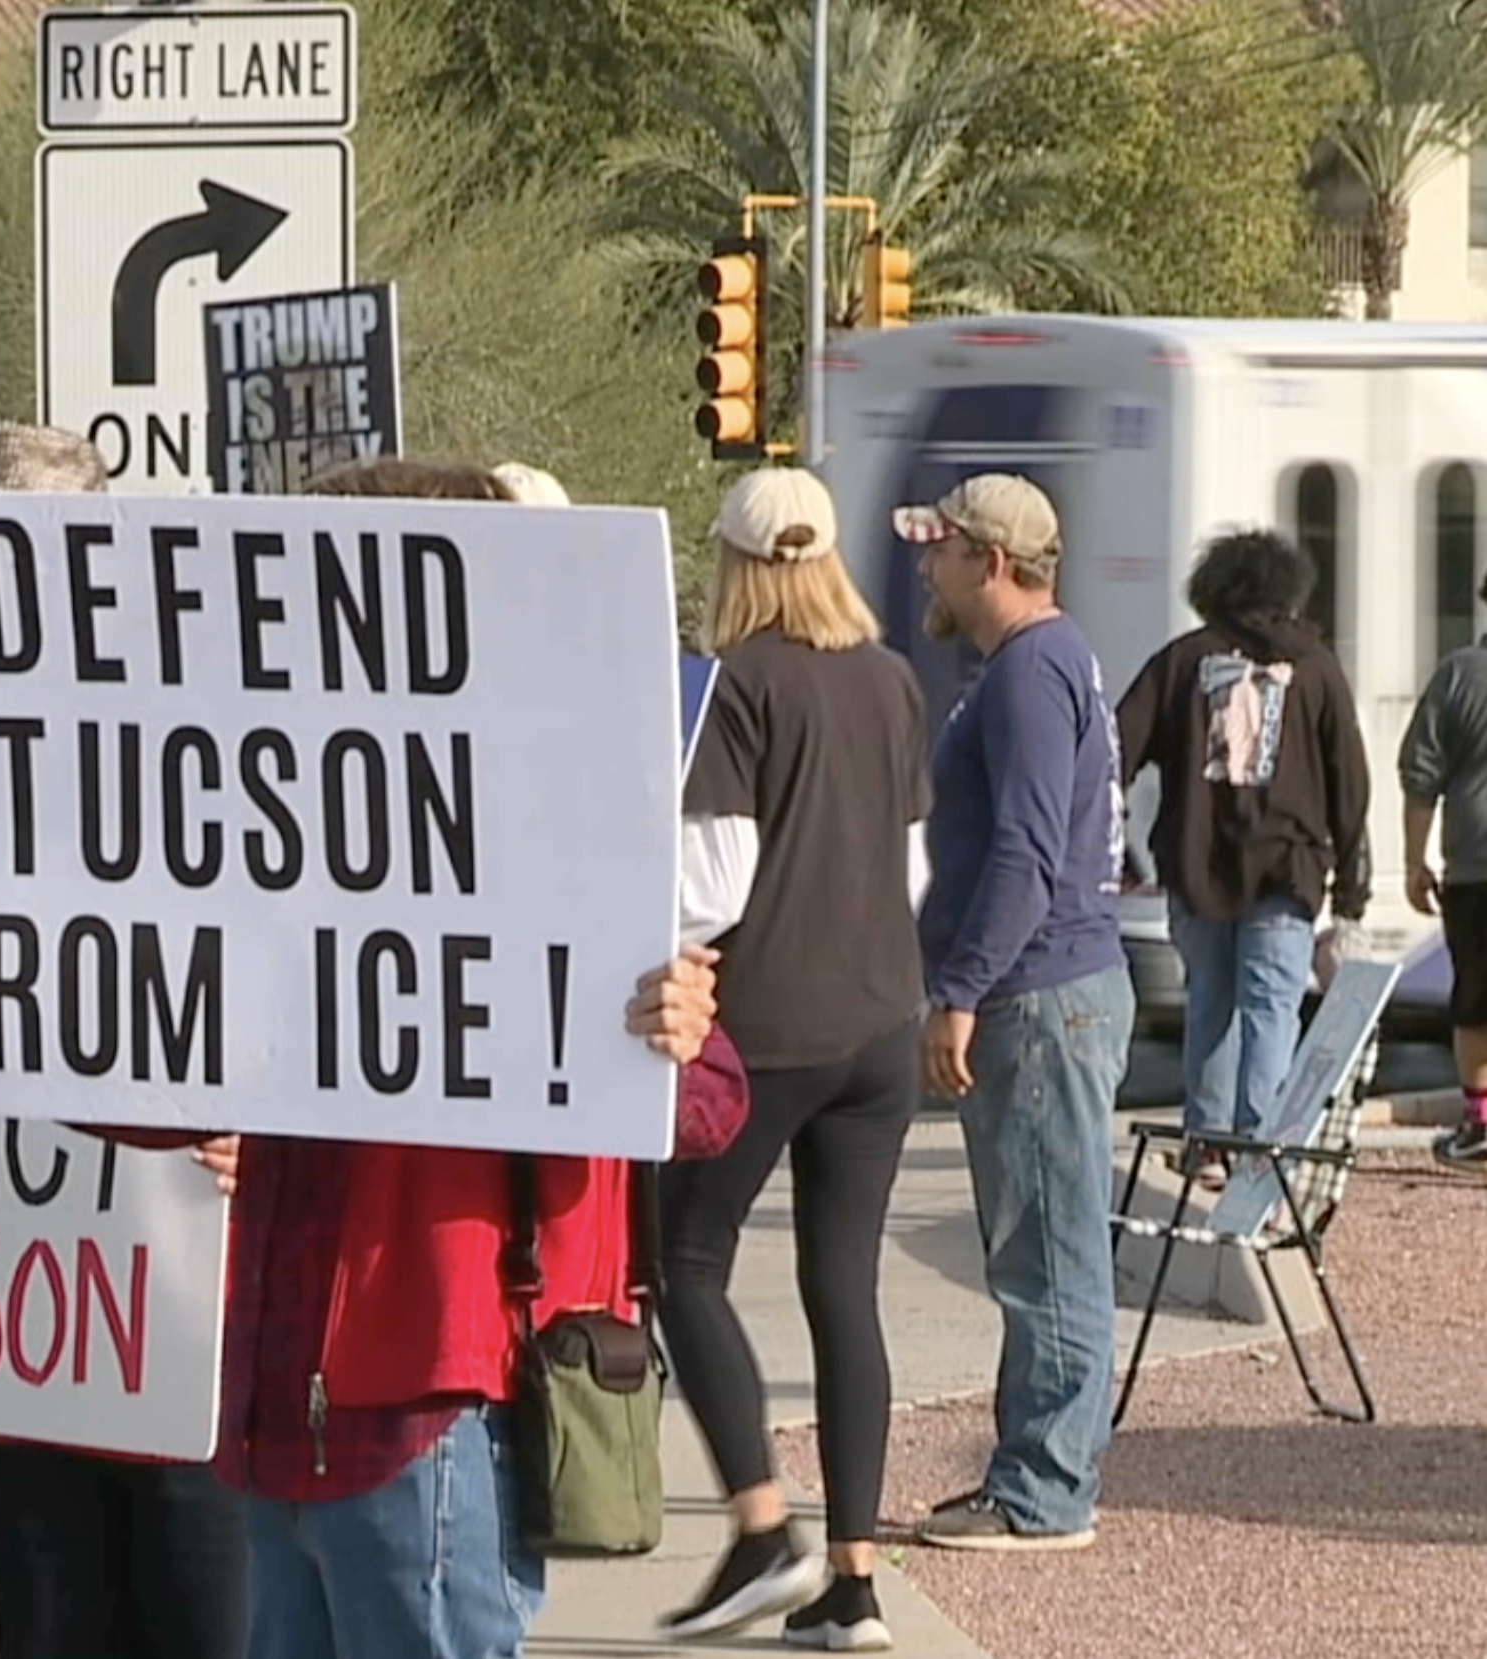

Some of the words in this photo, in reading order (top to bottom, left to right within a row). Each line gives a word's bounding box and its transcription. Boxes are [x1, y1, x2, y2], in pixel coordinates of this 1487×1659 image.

[59, 42, 195, 101] RIGHT
[217, 41, 332, 99] LANE
[210, 292, 378, 374] TRUMP
[226, 373, 276, 446] IS
[283, 364, 371, 437] THE
